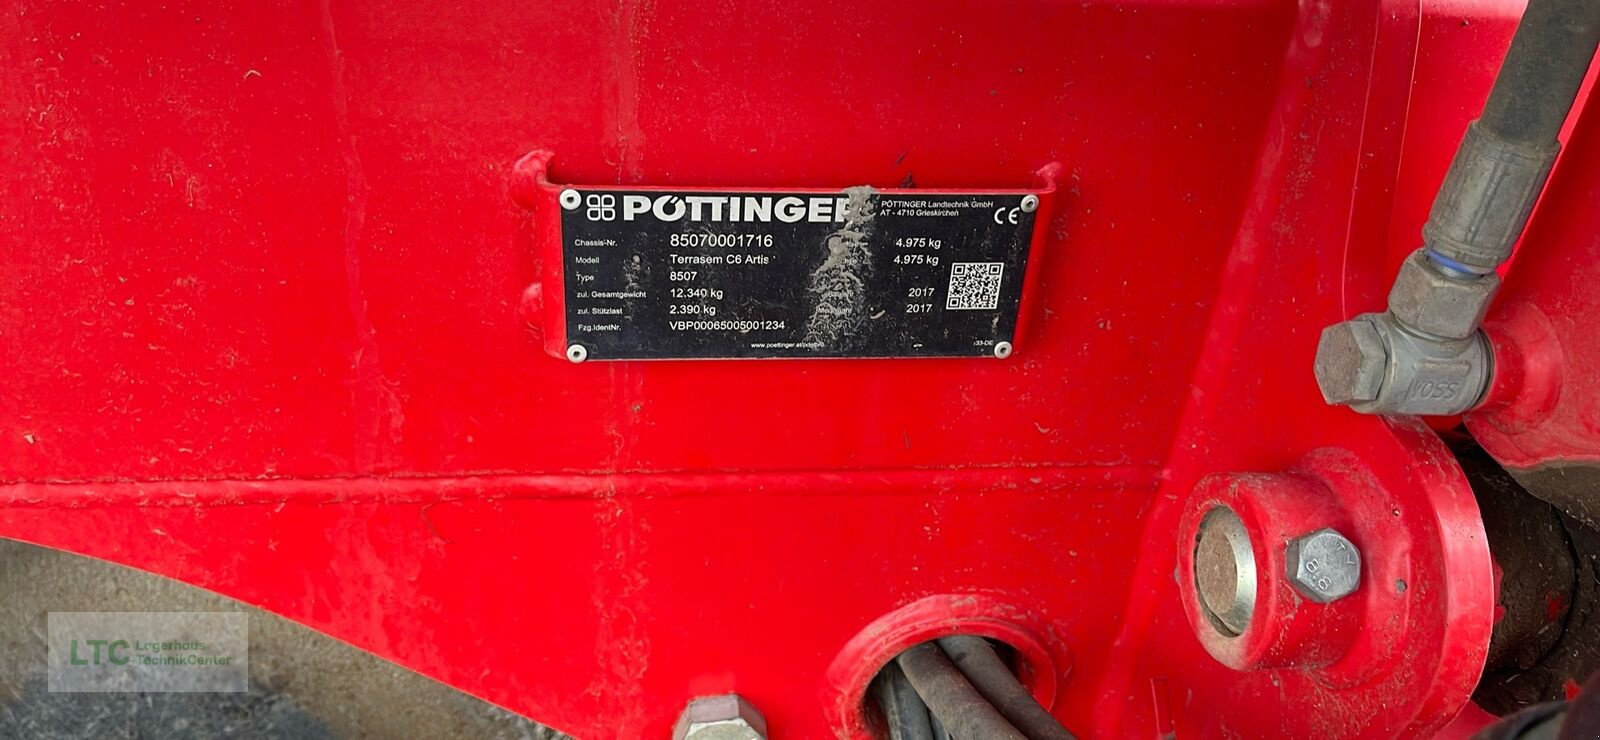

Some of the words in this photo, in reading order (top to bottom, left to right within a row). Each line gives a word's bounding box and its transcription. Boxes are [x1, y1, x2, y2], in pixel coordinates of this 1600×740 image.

[881, 200, 926, 208] PÖTTINGER
[928, 200, 969, 208] Landtechnik
[971, 200, 994, 208] GmbH
[916, 209, 959, 217] Grieskirchen
[574, 238, 618, 247] Chassis-Nr.
[670, 233, 773, 247] 85070001716
[895, 237, 926, 248] 4.975
[928, 237, 941, 250] kg
[575, 256, 600, 264] Modell
[669, 254, 723, 264] Terrasem
[726, 254, 742, 264] C6
[745, 254, 770, 265] Artis
[893, 254, 924, 265] 4.975
[926, 254, 939, 267] kg
[576, 273, 595, 284] Type
[669, 271, 698, 281] 8507
[591, 290, 647, 300] Gesamtgewicht
[670, 288, 708, 298] 12.340
[710, 288, 724, 300] kg
[908, 287, 935, 297] 2017
[577, 307, 590, 315] zul.
[591, 307, 623, 315] Stützlast
[669, 304, 701, 315] 2.390
[703, 304, 716, 316] kg
[906, 303, 933, 313] 2017
[669, 320, 785, 331] VBP00065005001234
